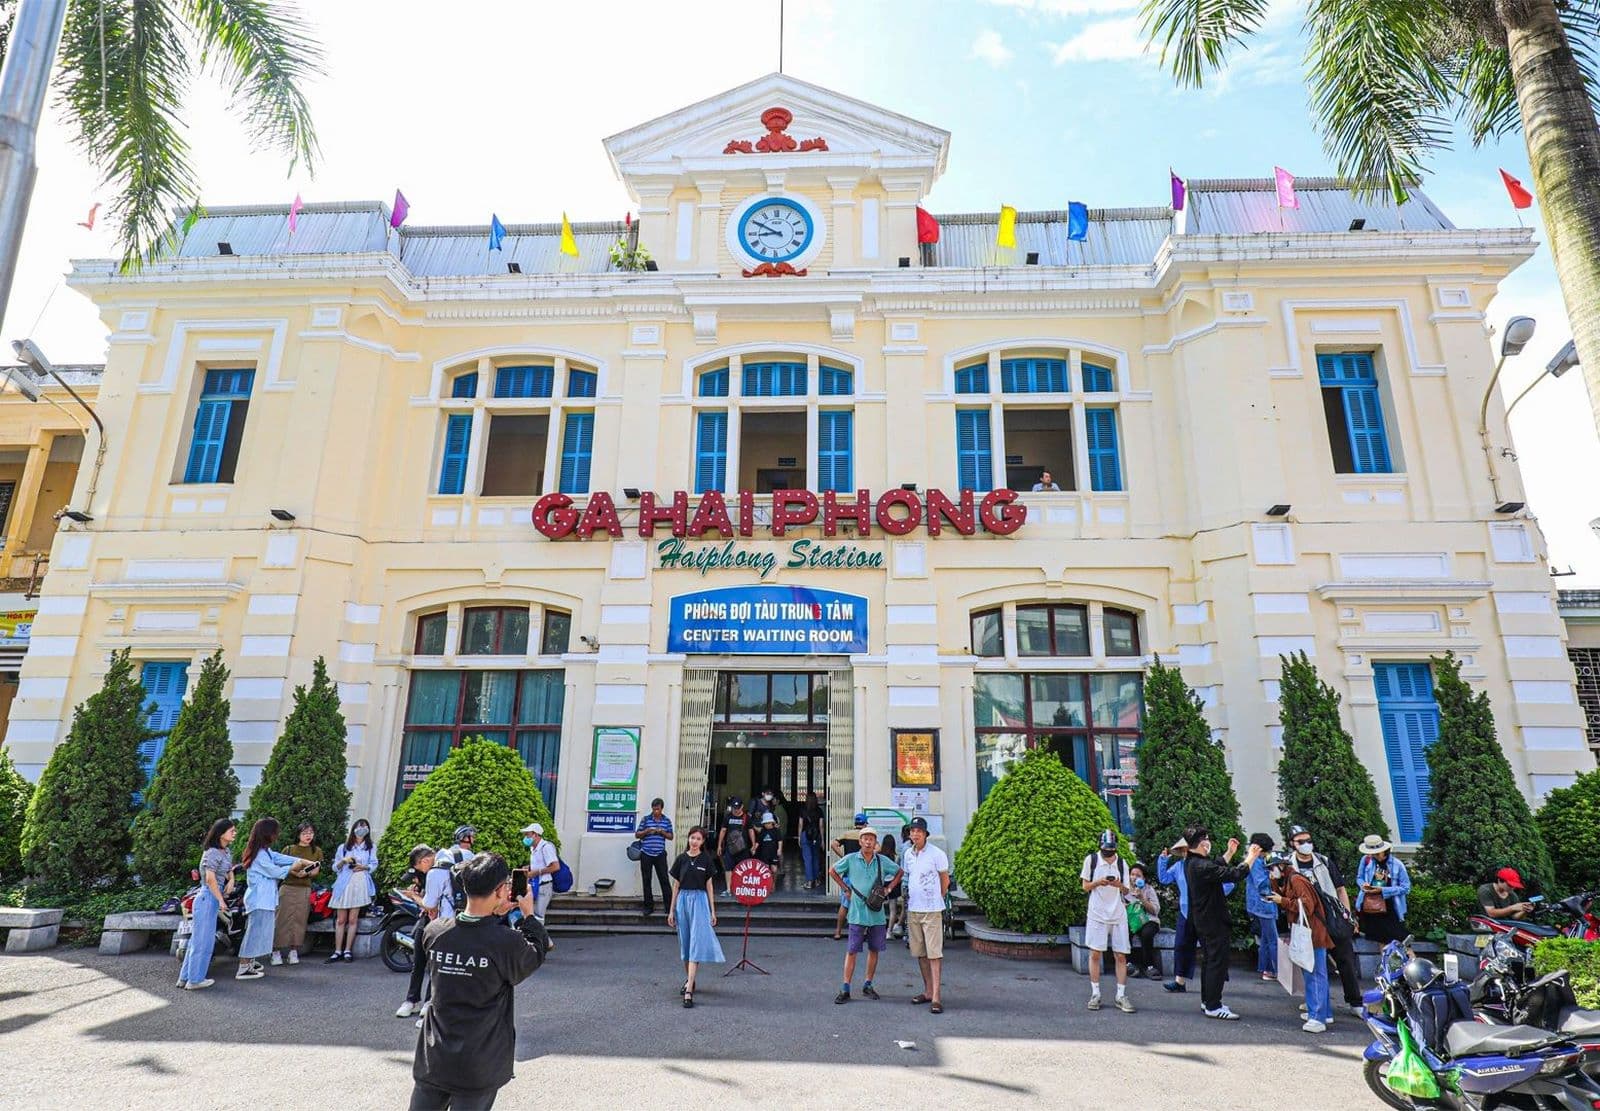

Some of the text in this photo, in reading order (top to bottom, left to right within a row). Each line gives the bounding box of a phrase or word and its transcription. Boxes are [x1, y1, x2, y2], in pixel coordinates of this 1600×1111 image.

[532, 488, 1027, 539] GA HAI PHONG
[657, 537, 883, 578] Haiphong Station
[684, 600, 853, 623] PHÒNG ĐỢI TÀU TRUNG TÂM
[683, 629, 853, 642] CENTER WAITING ROOM
[735, 860, 753, 876] KHU
[429, 950, 489, 968] TEELAB
